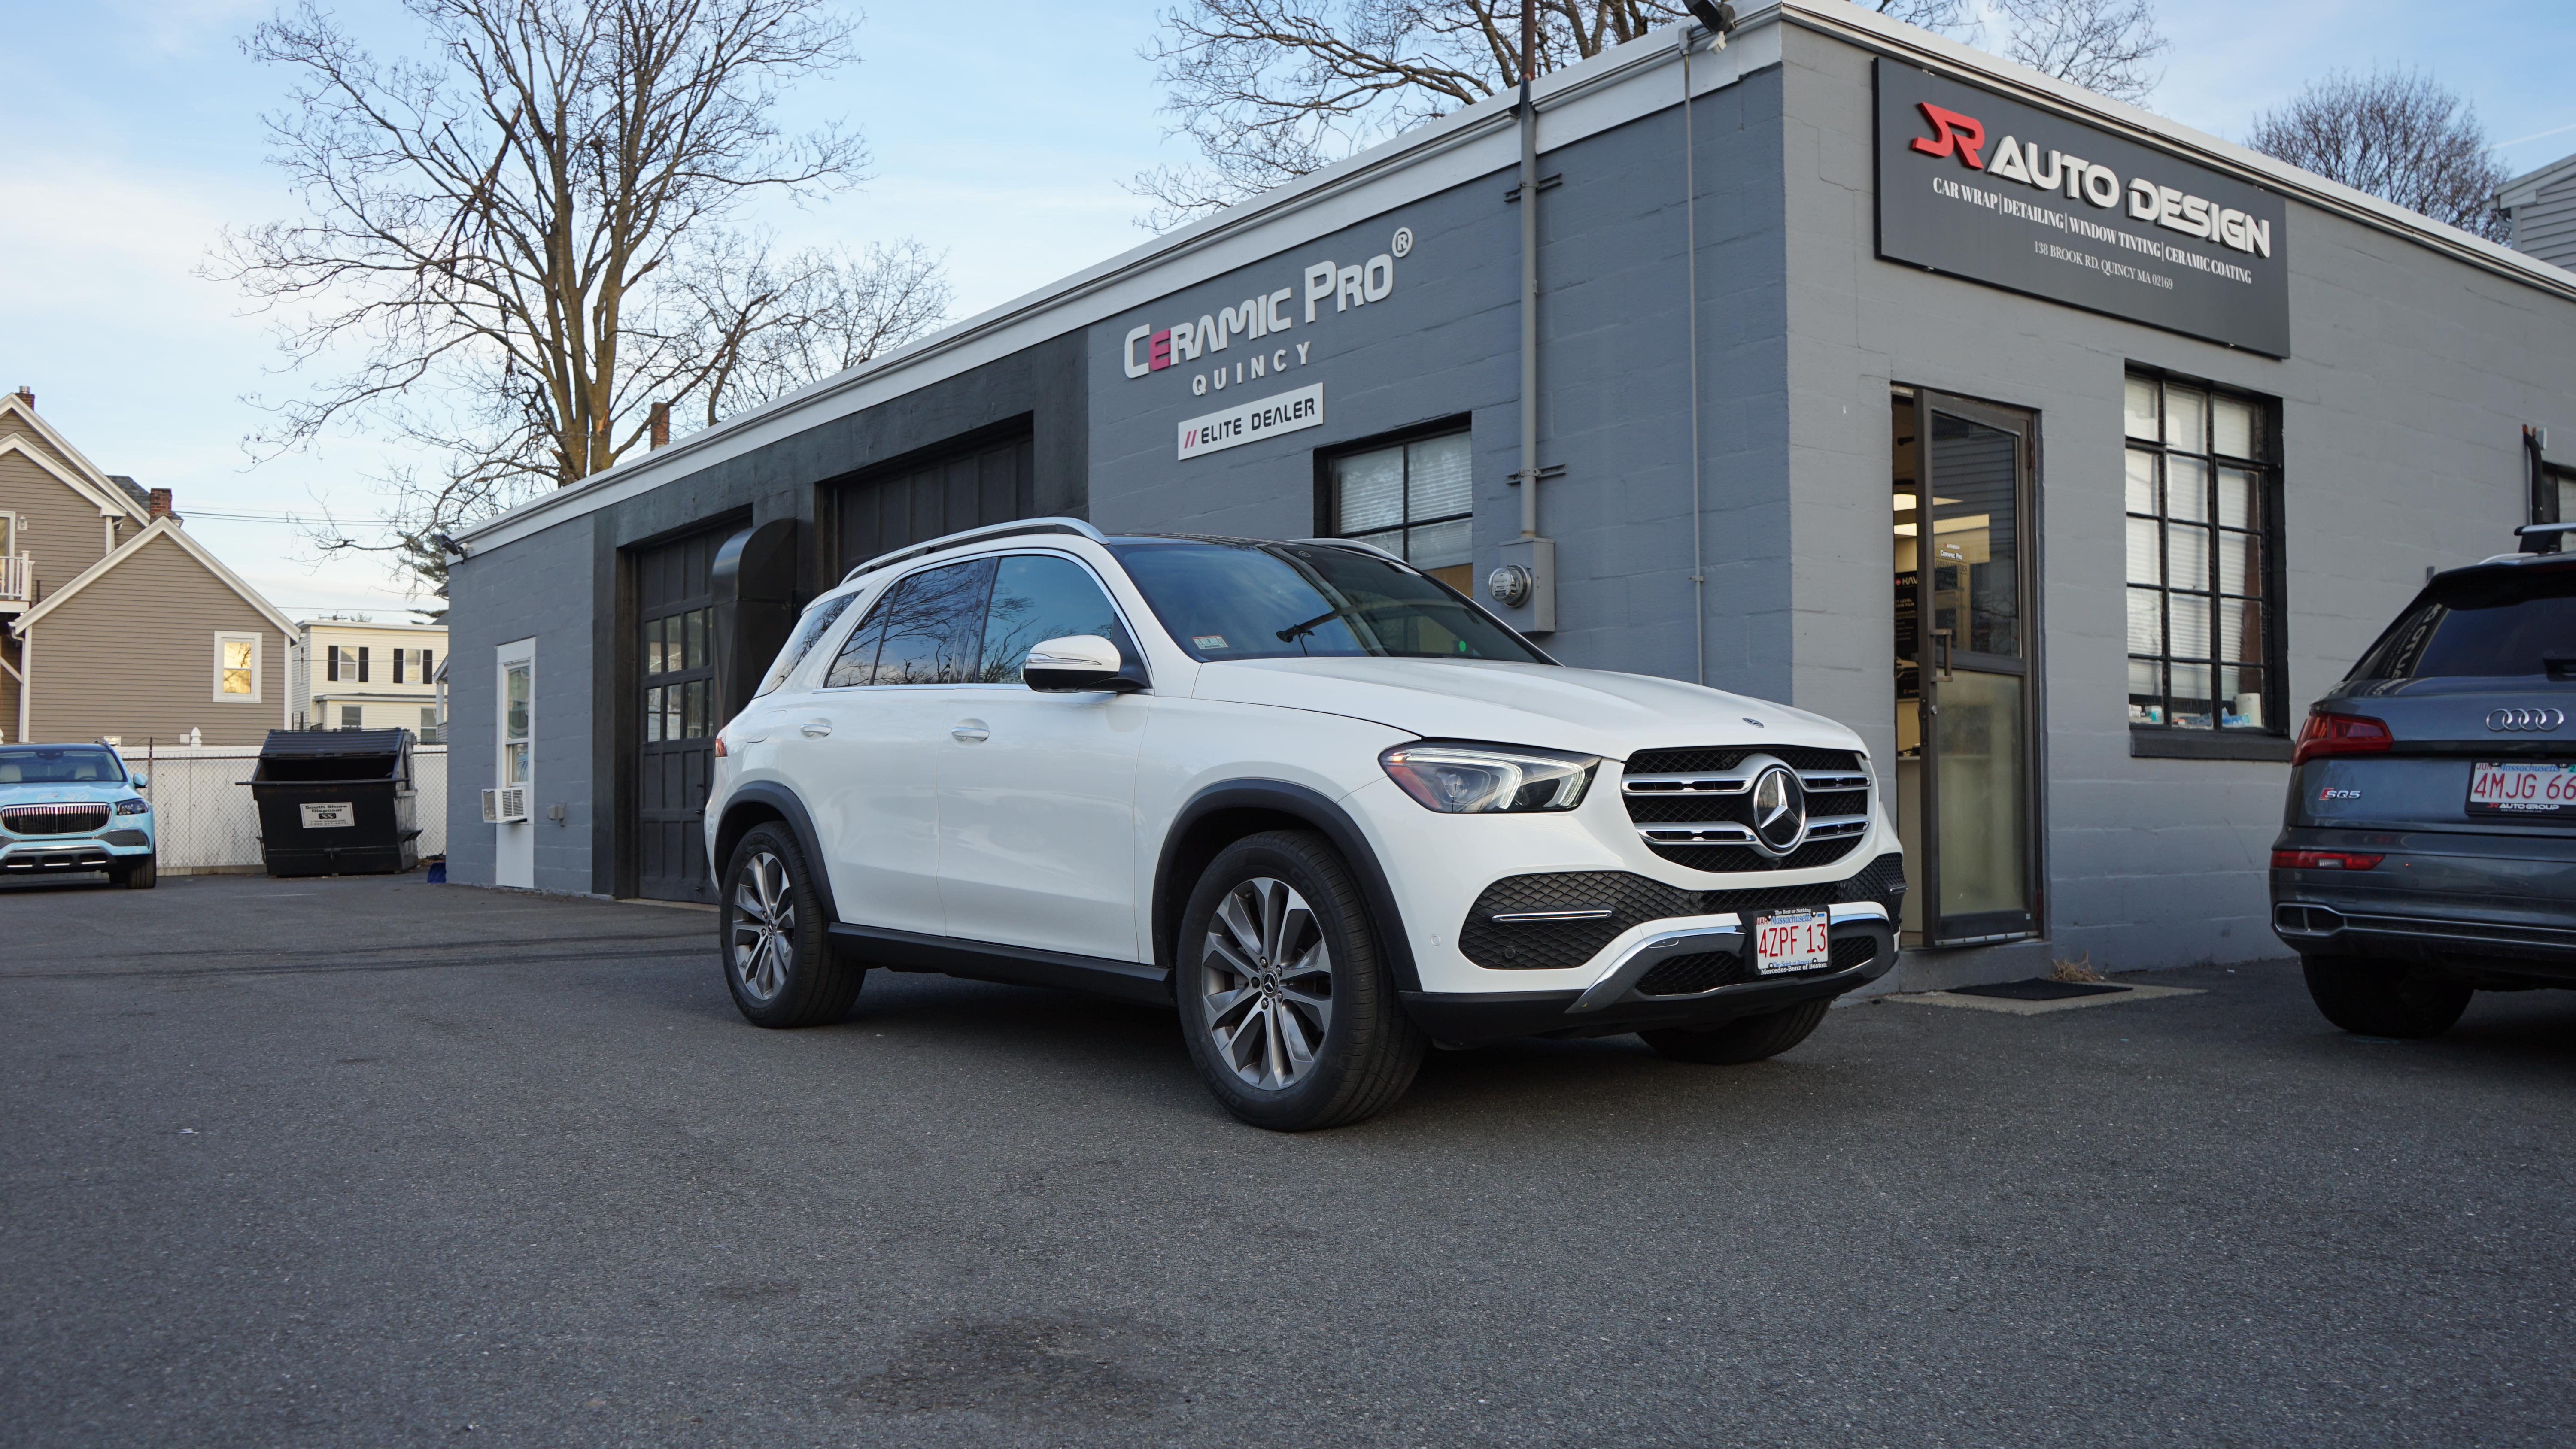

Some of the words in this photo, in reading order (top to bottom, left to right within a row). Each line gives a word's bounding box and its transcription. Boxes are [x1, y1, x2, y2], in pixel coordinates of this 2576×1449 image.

[1987, 135, 2120, 209] AUTO
[2128, 177, 2270, 258] DESIGN
[1933, 177, 1959, 199] CAR
[1961, 185, 1998, 209] WRAP
[2004, 197, 2064, 229] DETAILING
[2069, 216, 2117, 245] WINDOW
[2118, 231, 2161, 258] TINTING
[2165, 246, 2210, 272] CERAMIC
[2211, 259, 2251, 284] COATING
[2034, 240, 2049, 255] 138
[2050, 244, 2083, 265] BROOK
[2085, 254, 2100, 270] RD.
[2101, 260, 2136, 279] QUINCY
[2137, 269, 2151, 284] MA
[2152, 274, 2173, 290] 02169
[1124, 288, 1291, 379] CERAMIC
[1192, 341, 1310, 396] QUINCY
[1201, 417, 1242, 444] ELITE
[1252, 397, 1315, 431] DEALER
[2474, 773, 2537, 799] 4MJG
[2546, 773, 2576, 800] 66
[2497, 763, 2561, 772] Massachusetts
[2325, 789, 2361, 799] SQ5
[1756, 917, 1768, 925] MAR
[1771, 914, 1812, 925] Massachusetts
[1759, 925, 1799, 958] 4ZPF
[1807, 923, 1826, 954] 13
[1761, 966, 1801, 975] Mercedes-Benz
